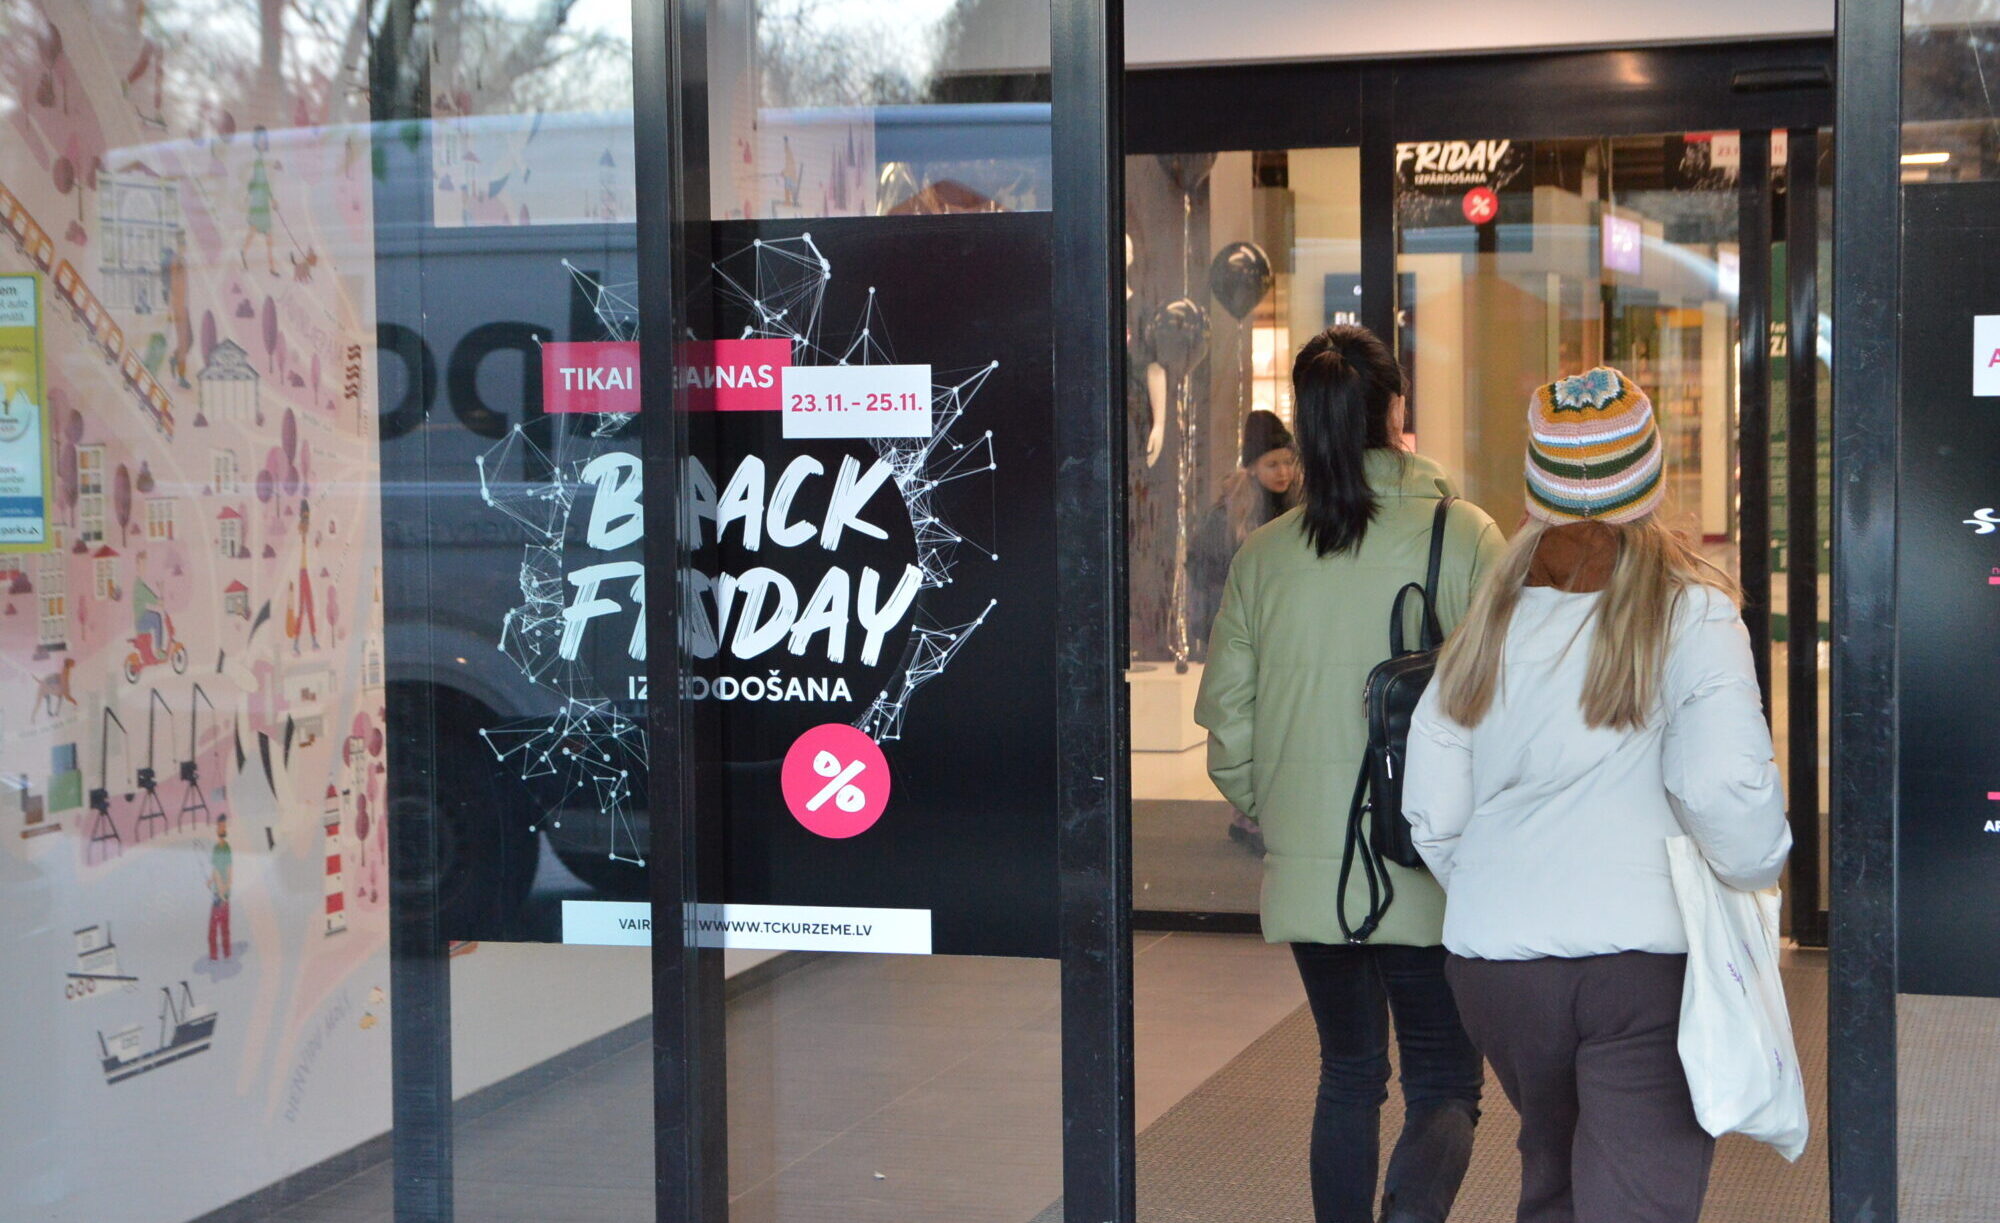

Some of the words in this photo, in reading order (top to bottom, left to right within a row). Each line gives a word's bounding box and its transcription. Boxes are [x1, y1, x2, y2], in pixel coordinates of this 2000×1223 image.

[1396, 139, 1511, 173] FRIDAY
[560, 367, 633, 390] TIKAI
[618, 918, 651, 931] VAIR
